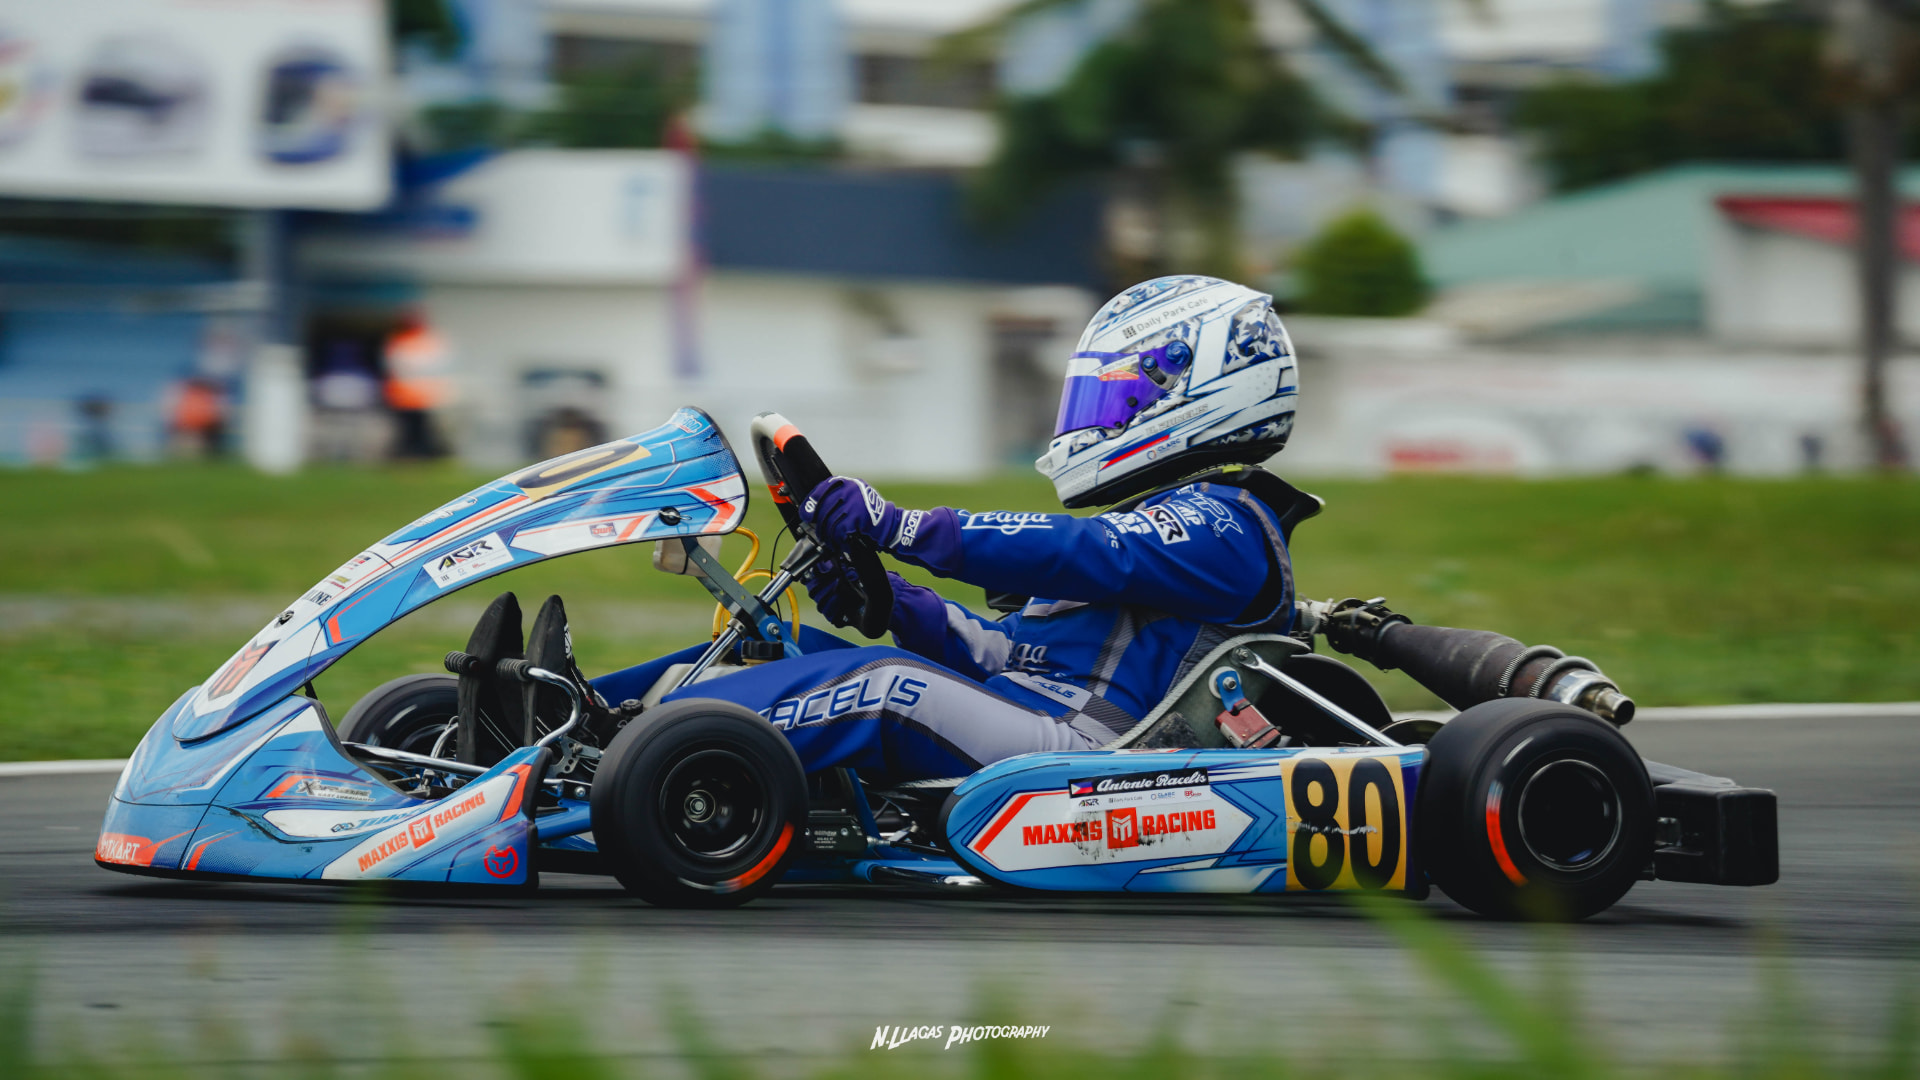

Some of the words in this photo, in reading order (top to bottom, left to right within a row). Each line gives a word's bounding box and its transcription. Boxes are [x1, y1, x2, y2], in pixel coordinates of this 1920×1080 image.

[1136, 316, 1162, 332] Daily
[1162, 306, 1187, 319] Park
[1032, 680, 1077, 699] CELIS
[1097, 779, 1155, 792] Antonio
[1156, 771, 1207, 787] Racelis
[358, 831, 409, 872] MAXXIS
[434, 791, 486, 828] RACING
[1022, 820, 1103, 846] MAXXIS
[1141, 809, 1216, 836] RACING
[1291, 757, 1401, 889] 80
